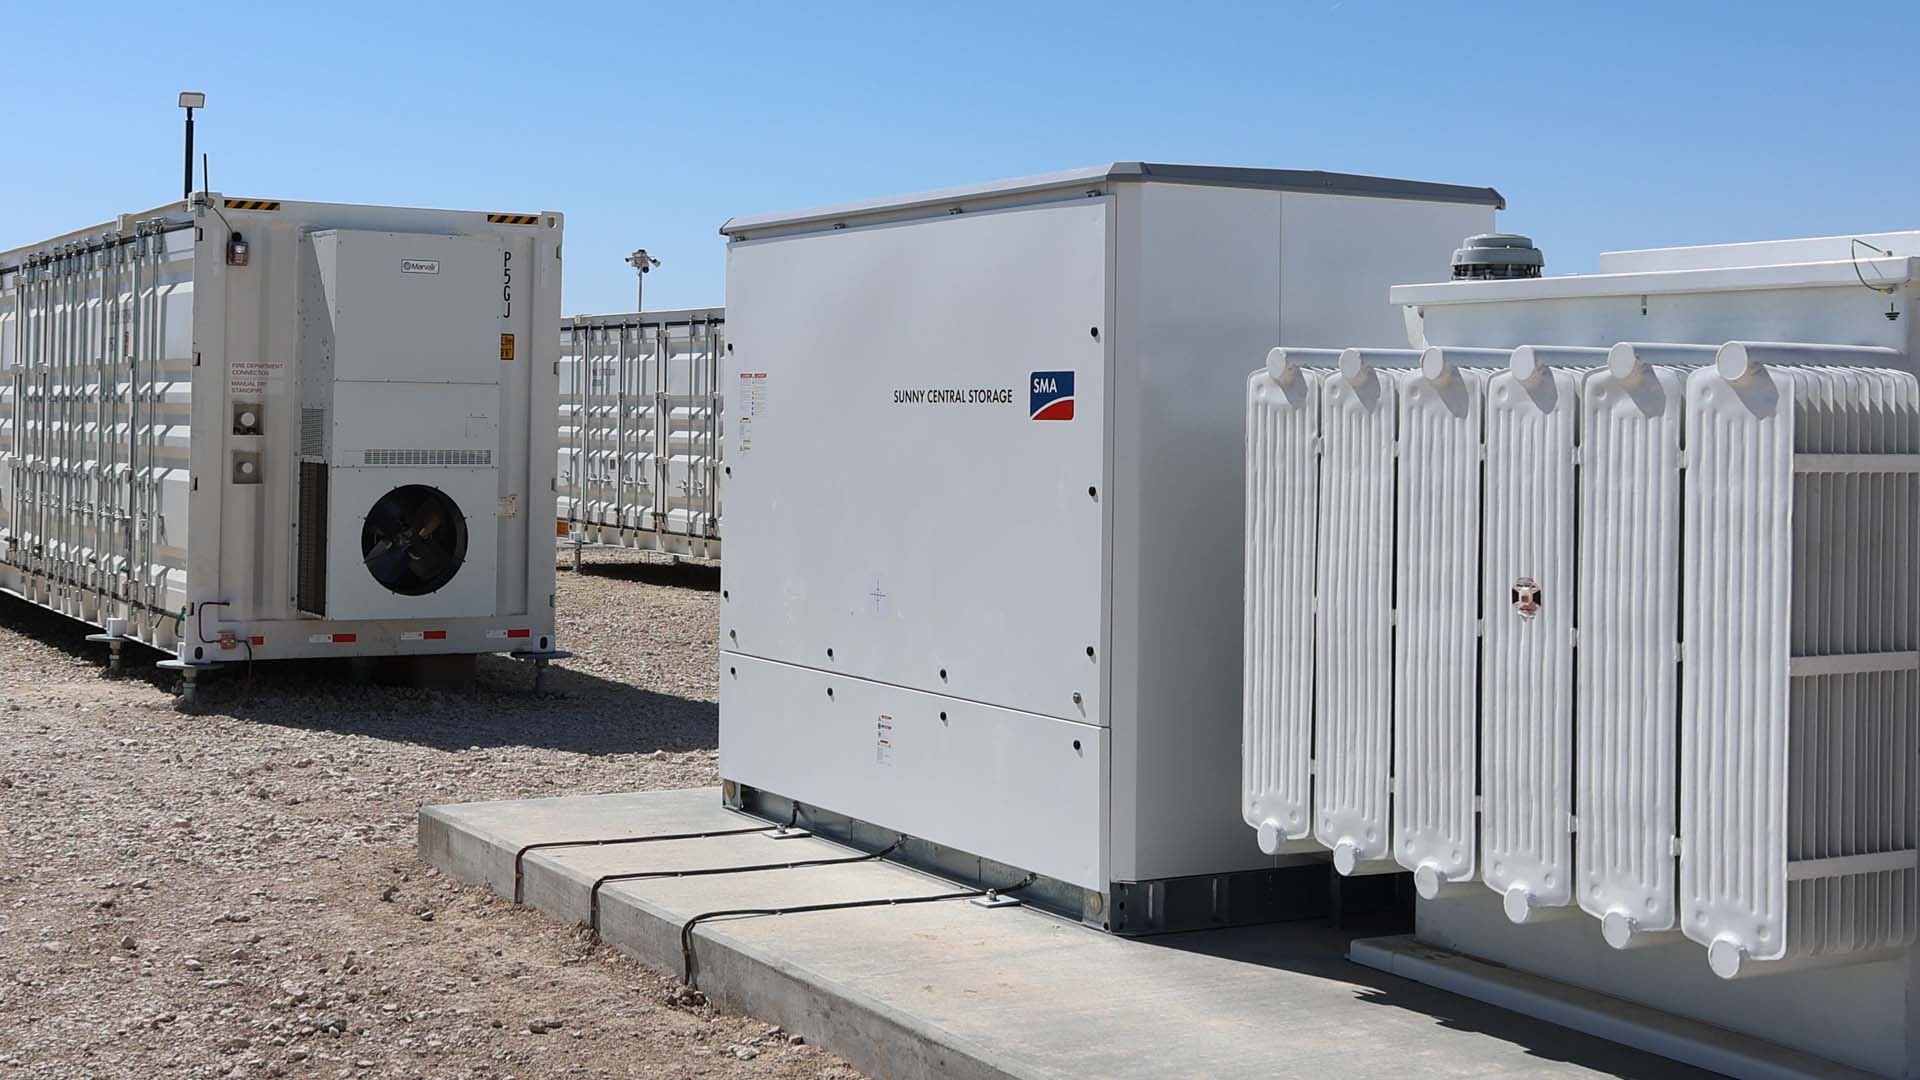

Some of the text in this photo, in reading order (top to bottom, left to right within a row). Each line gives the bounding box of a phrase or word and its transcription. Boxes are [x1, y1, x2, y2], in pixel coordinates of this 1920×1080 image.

[503, 251, 512, 319] P5GJ
[1033, 378, 1058, 393] SMA
[893, 389, 1013, 404] SUNNY CENTRAL STORAGE
